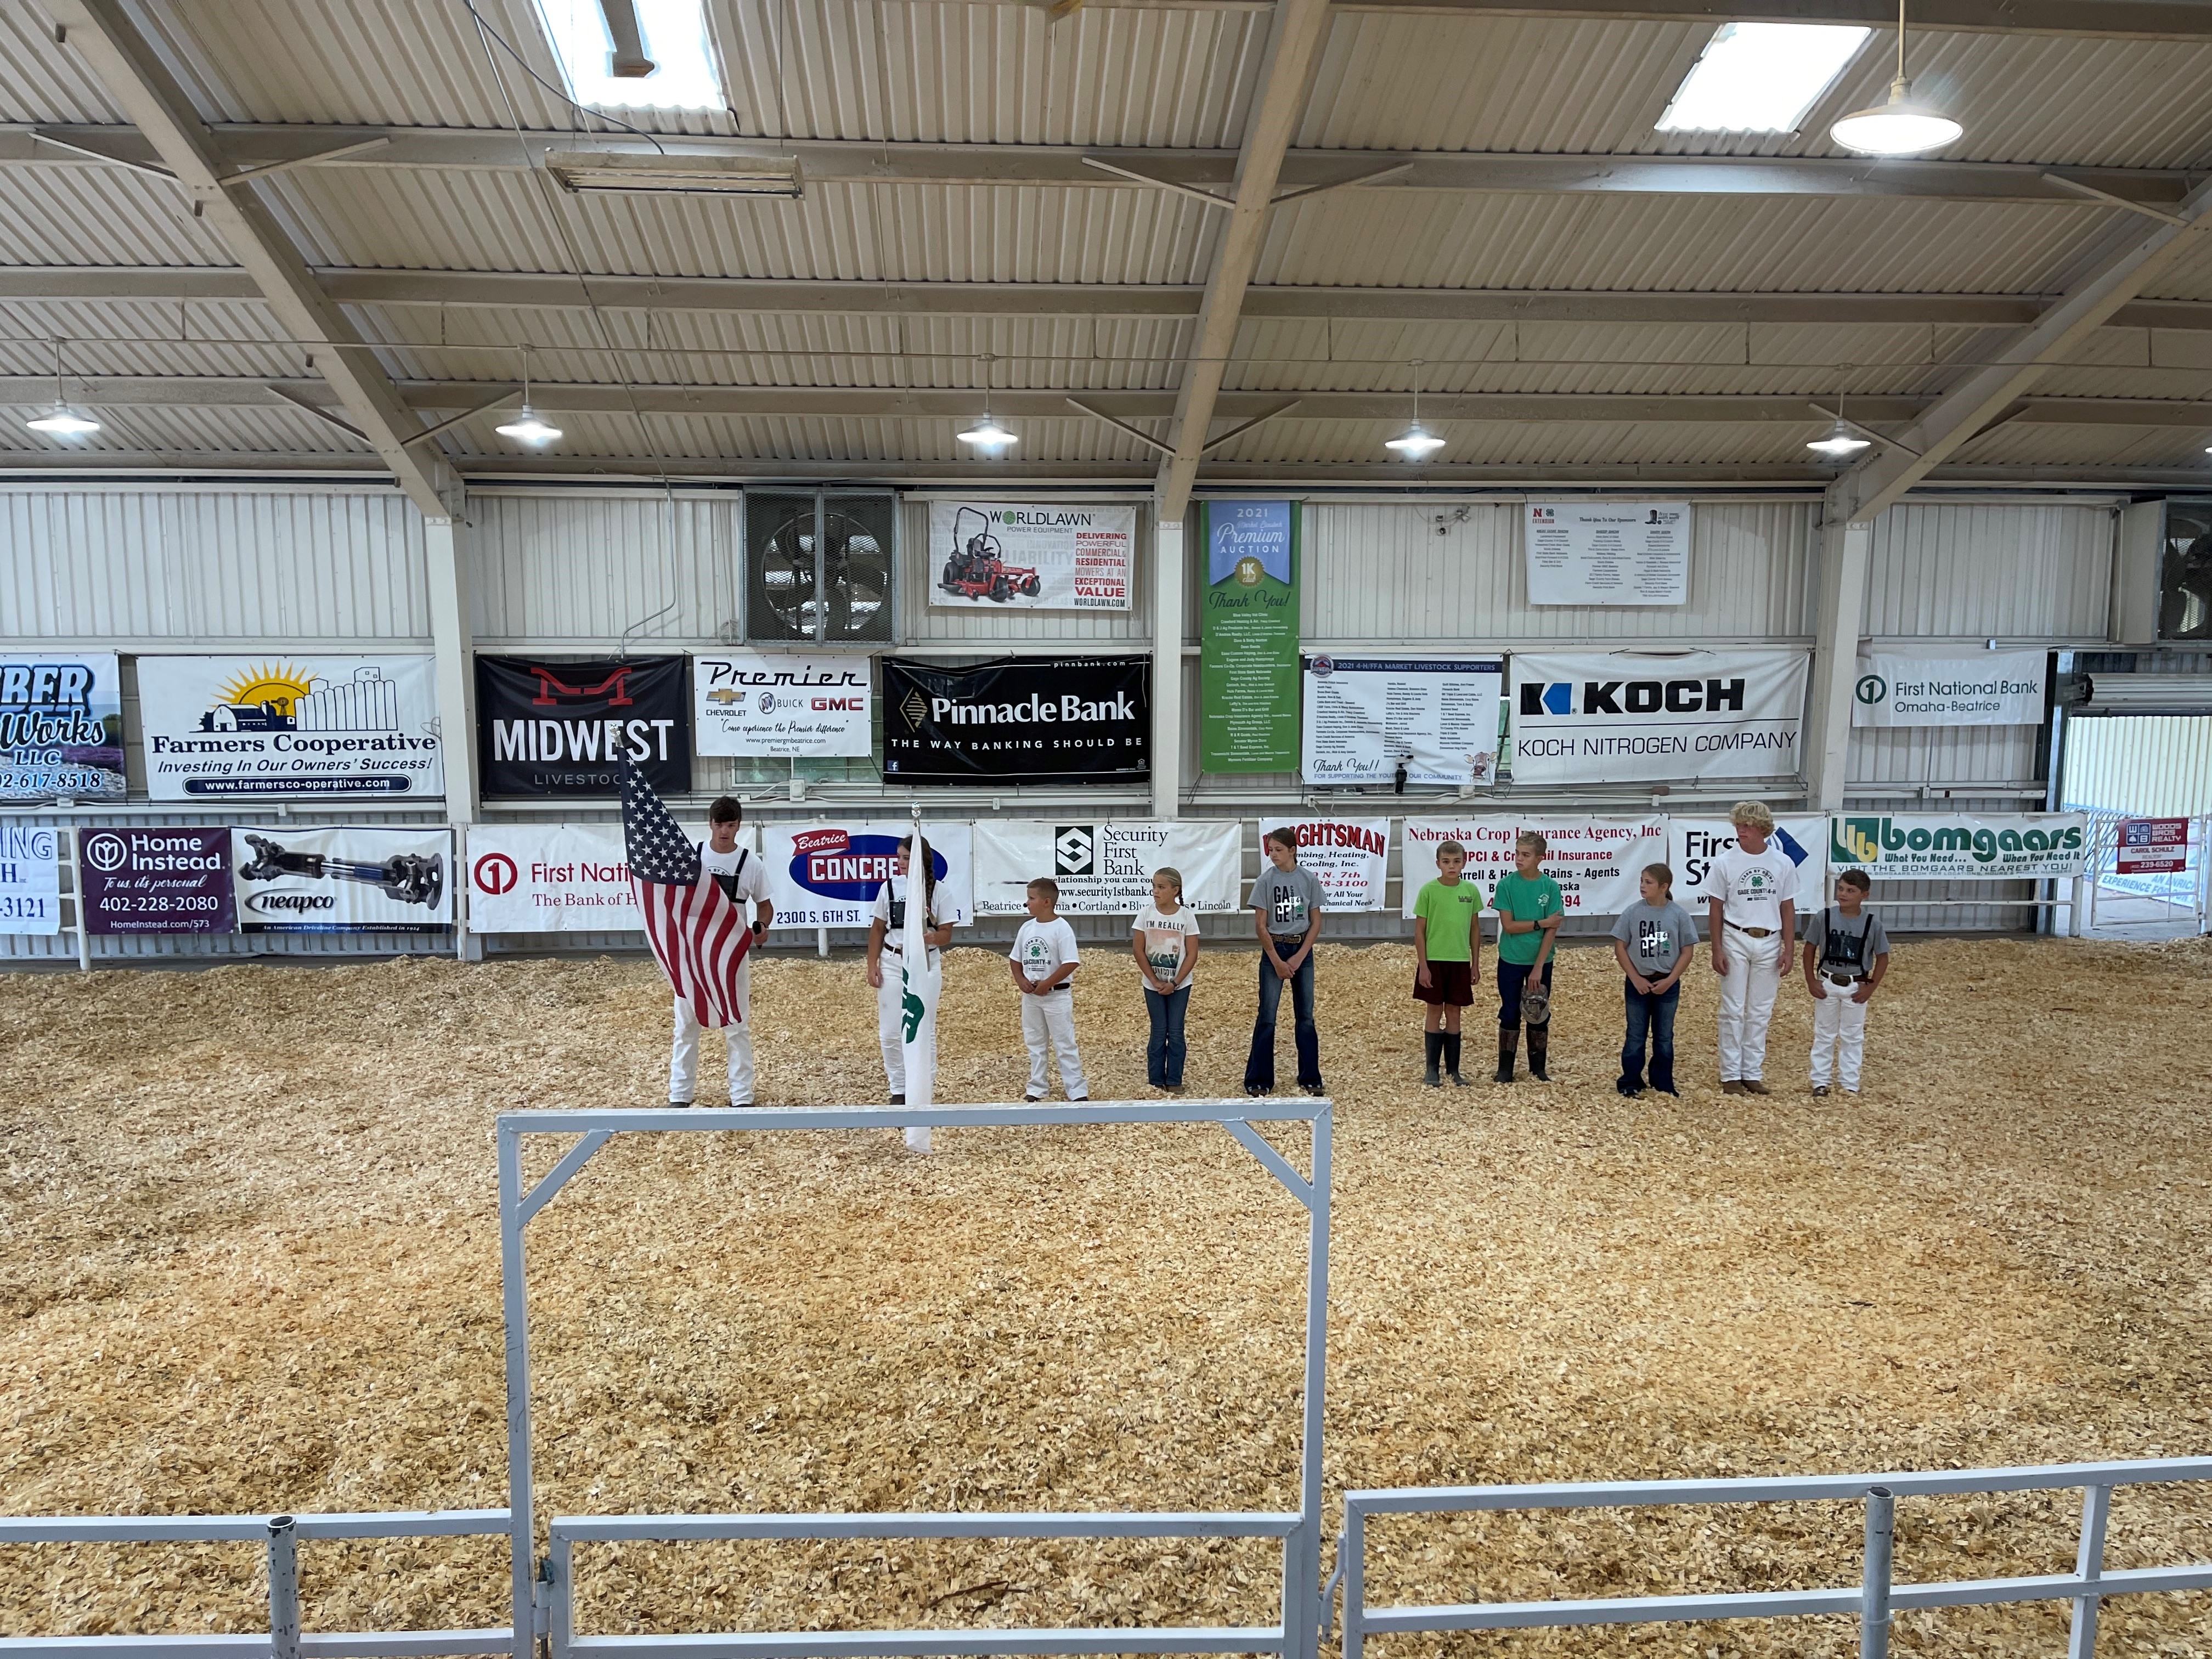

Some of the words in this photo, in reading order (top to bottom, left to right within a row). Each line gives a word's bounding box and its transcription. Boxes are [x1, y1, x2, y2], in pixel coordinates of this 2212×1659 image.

[1237, 509, 1268, 517] 2021
[1217, 523, 1285, 544] Premium
[1076, 558, 1126, 567] RESIDENTIAL
[1242, 563, 1255, 574] 1K
[1075, 567, 1104, 576] MOWERS
[1108, 568, 1114, 576] AT
[1118, 568, 1126, 577] AN
[1075, 577, 1125, 586] EXCEPTIONAL
[1075, 586, 1125, 597] VALUE
[1074, 598, 1125, 607] WORLDLAWN.COM
[1209, 591, 1250, 609] Thank
[1255, 590, 1290, 609] You!
[701, 662, 867, 686] Premier
[1895, 682, 1924, 696] First
[1929, 680, 1997, 695] National
[2001, 680, 2038, 694] Bank
[777, 699, 803, 708] BUICK
[811, 697, 864, 710] GMC
[1584, 679, 1745, 714] KOCH
[932, 693, 1057, 724] Pinnacle
[1062, 691, 1135, 721] Bank
[1895, 701, 2000, 712] Omaha-Beatrice
[0, 710, 104, 749] Works
[743, 724, 772, 735] experience
[775, 723, 786, 732] the
[788, 720, 814, 734] Premier
[151, 736, 265, 753] Farmers
[273, 733, 436, 755] Cooperative
[494, 719, 674, 761] MIDWEST
[891, 739, 920, 748] THE
[931, 741, 962, 749] WAY
[972, 741, 1043, 750] BANKING
[1053, 738, 1115, 748] SHOULD
[1519, 739, 1575, 757] KOCH
[1584, 737, 1687, 755] NITROGEN
[1695, 731, 1797, 752] COMPANY
[15, 751, 60, 765] LLC
[1313, 759, 1343, 772] Thank
[1347, 758, 1380, 772] You!!
[157, 760, 233, 774] Investing
[236, 760, 252, 771] In
[257, 760, 287, 771] Our
[291, 759, 356, 771] Owners'
[360, 758, 432, 769] Success!
[0, 774, 100, 788] 2-617-8518
[205, 779, 390, 790] www.farmersco-operative.com
[535, 774, 621, 785] LIVESTOC
[1103, 825, 1169, 847] Security
[1408, 828, 1471, 841] Nebraska
[1476, 827, 1510, 843] Crop
[1584, 825, 1637, 842] Agency,
[1641, 824, 1661, 837] Inc
[1881, 817, 2081, 862] bomgaars
[131, 834, 202, 851] Home
[797, 834, 845, 850] Beatrice
[1103, 842, 1137, 859] First
[1491, 851, 1499, 861] &
[1558, 850, 1612, 861] Insurance
[1885, 853, 1908, 862] What
[1911, 853, 1927, 862] You
[1930, 853, 1966, 862] Need...
[2003, 853, 2027, 862] When
[2030, 852, 2044, 862] You
[2046, 851, 2070, 861] Need
[2072, 850, 2080, 860] It
[532, 863, 574, 882] First
[582, 863, 629, 882] Nati
[811, 857, 899, 881] CONCRE
[1103, 859, 1145, 876] Bank
[1488, 869, 1496, 879] &
[1584, 867, 1620, 879] Agents
[1980, 863, 2038, 872] NEAREST
[2042, 862, 2072, 871] YOU!
[104, 877, 117, 891] To
[149, 874, 207, 893] personal
[2102, 874, 2151, 892] EXPERIENCE
[100, 896, 218, 911] 402-228-2080
[261, 895, 334, 915] neapco
[532, 894, 561, 906] The
[565, 893, 603, 906] Bank
[608, 893, 623, 905] of
[983, 901, 1022, 910] Beatrice
[1079, 901, 1120, 911] Cortland
[1198, 900, 1231, 910] Lincoln
[111, 919, 210, 928] HomeInstead.com/573
[777, 911, 805, 924] 2300
[810, 911, 819, 923] S.
[823, 910, 843, 923] 6TH
[847, 910, 860, 922] ST.
[1158, 921, 1184, 930] REALLY
